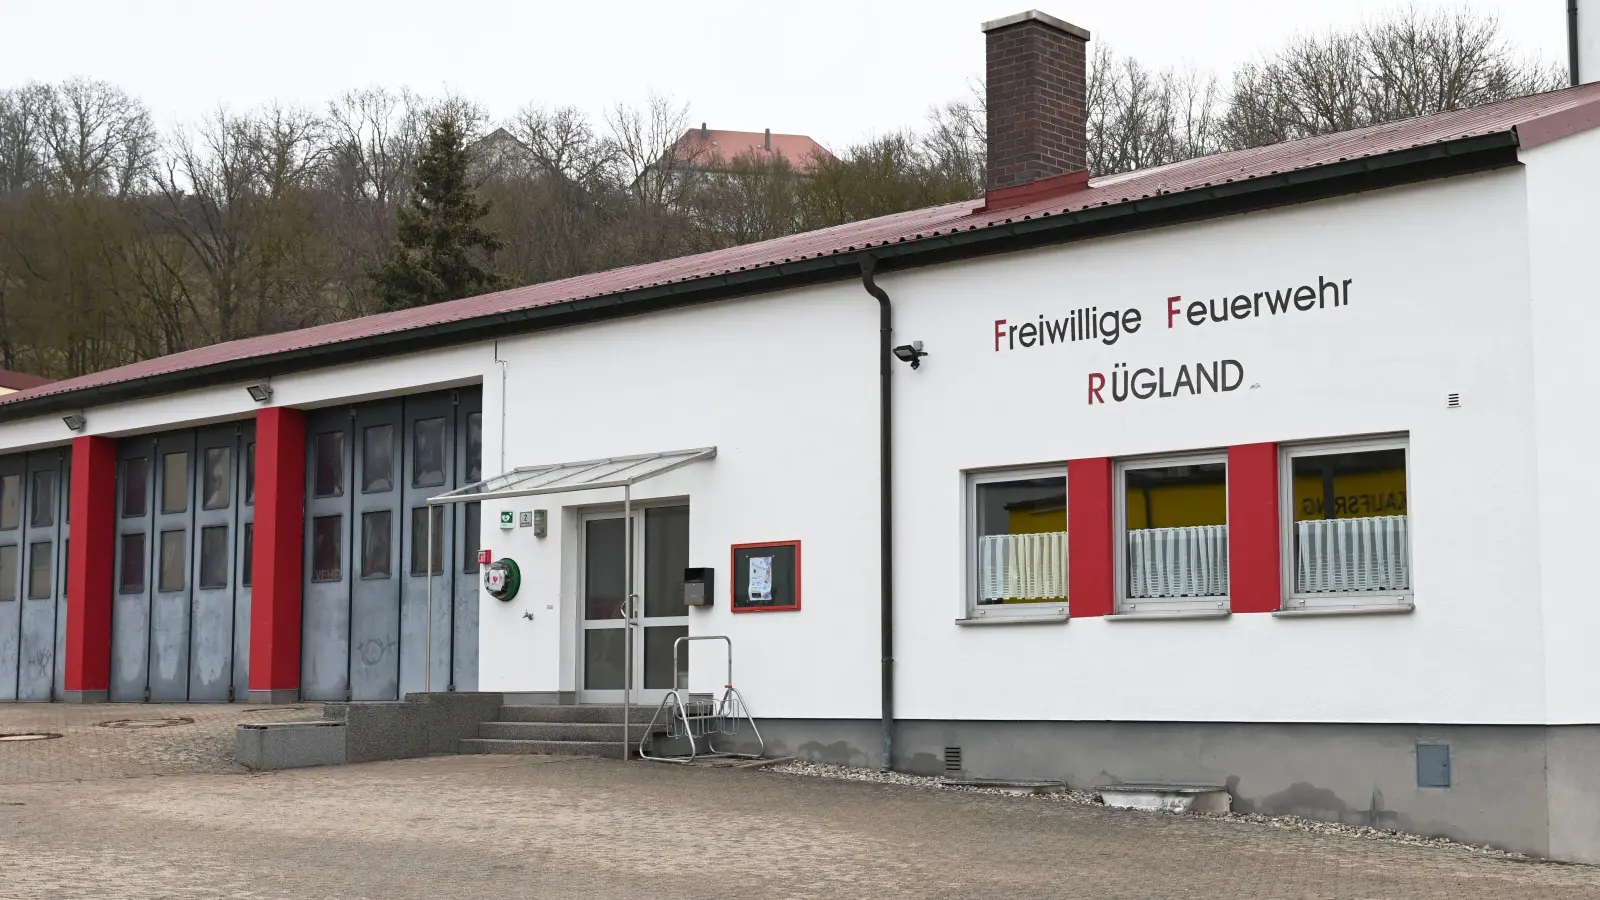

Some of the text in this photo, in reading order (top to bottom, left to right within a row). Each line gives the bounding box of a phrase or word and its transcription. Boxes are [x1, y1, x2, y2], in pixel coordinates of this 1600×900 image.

[994, 275, 1353, 352] Freiwillige Feuerwehr
[1088, 359, 1244, 405] RÜGLAND
